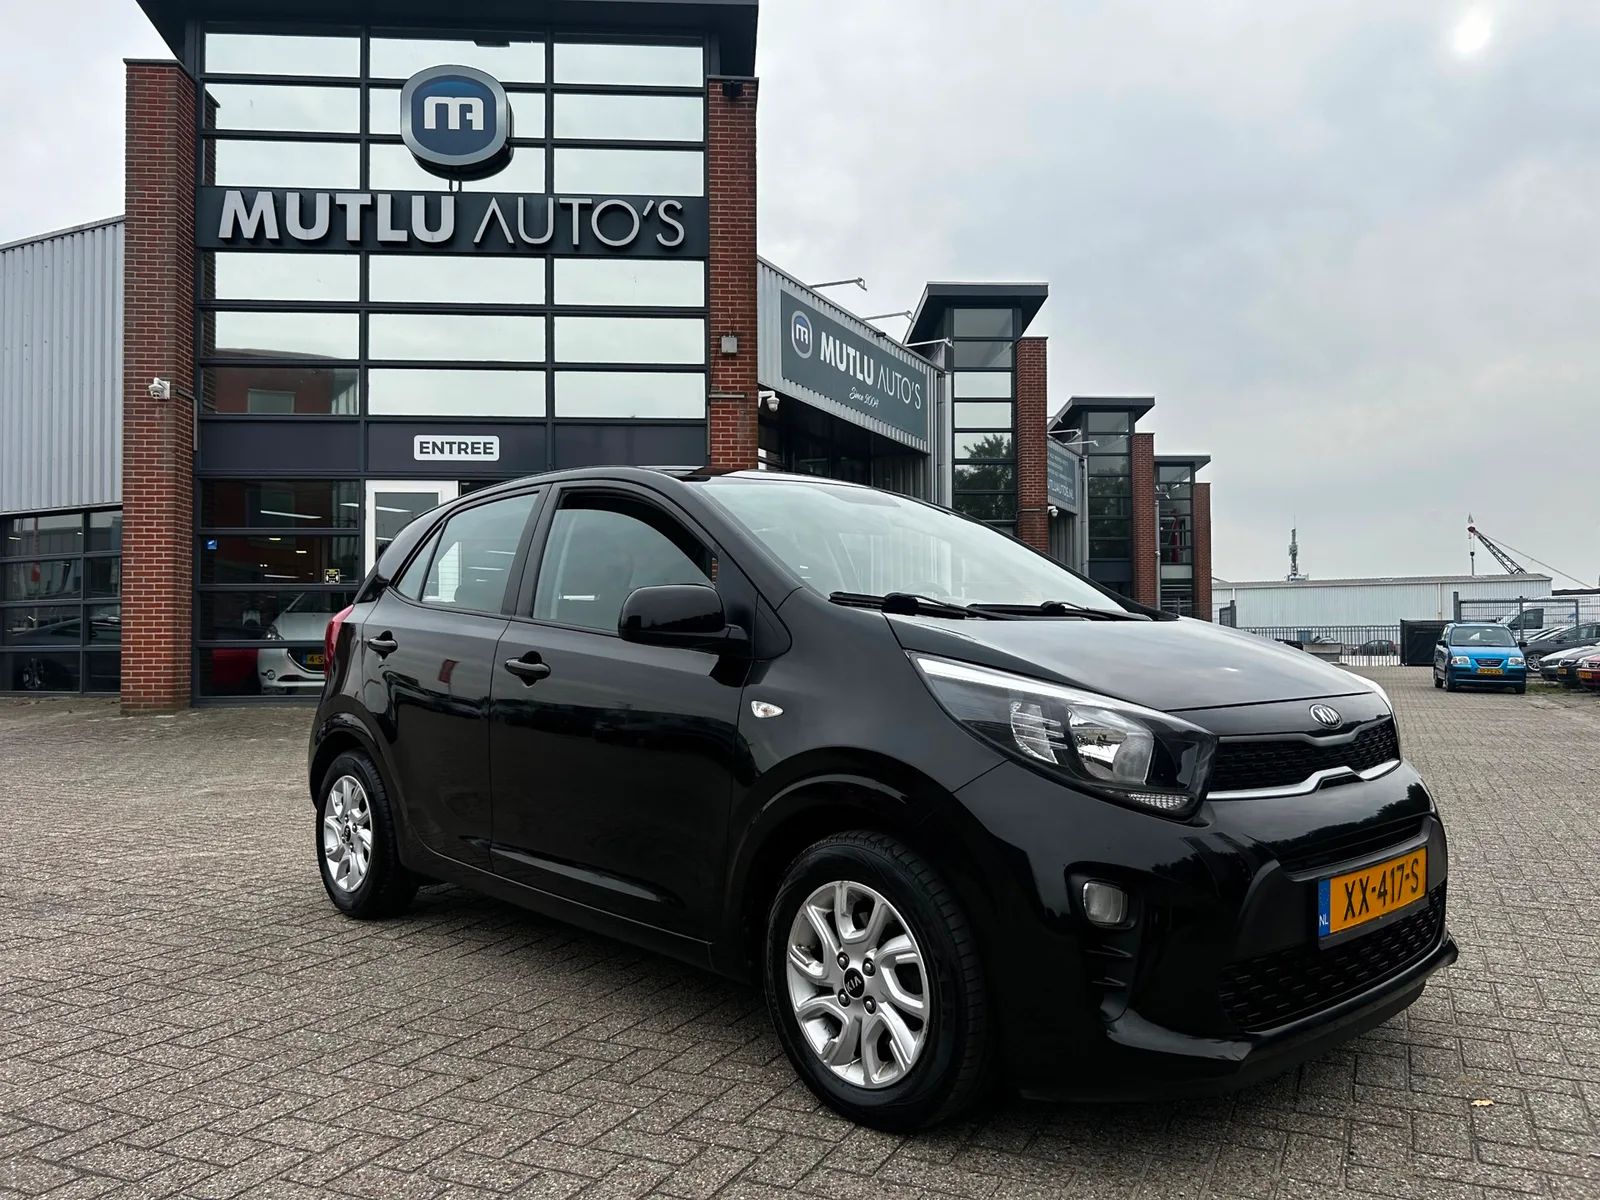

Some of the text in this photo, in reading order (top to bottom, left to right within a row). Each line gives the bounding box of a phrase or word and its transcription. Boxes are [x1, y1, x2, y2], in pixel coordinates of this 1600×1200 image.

[217, 190, 686, 247] MUTLU AUTO'S
[820, 331, 922, 410] MUTLU AUTO'S
[419, 441, 494, 455] ENTREE
[1344, 858, 1419, 922] XX-417-S
[1319, 913, 1329, 927] NL
[845, 975, 862, 993] KIA
